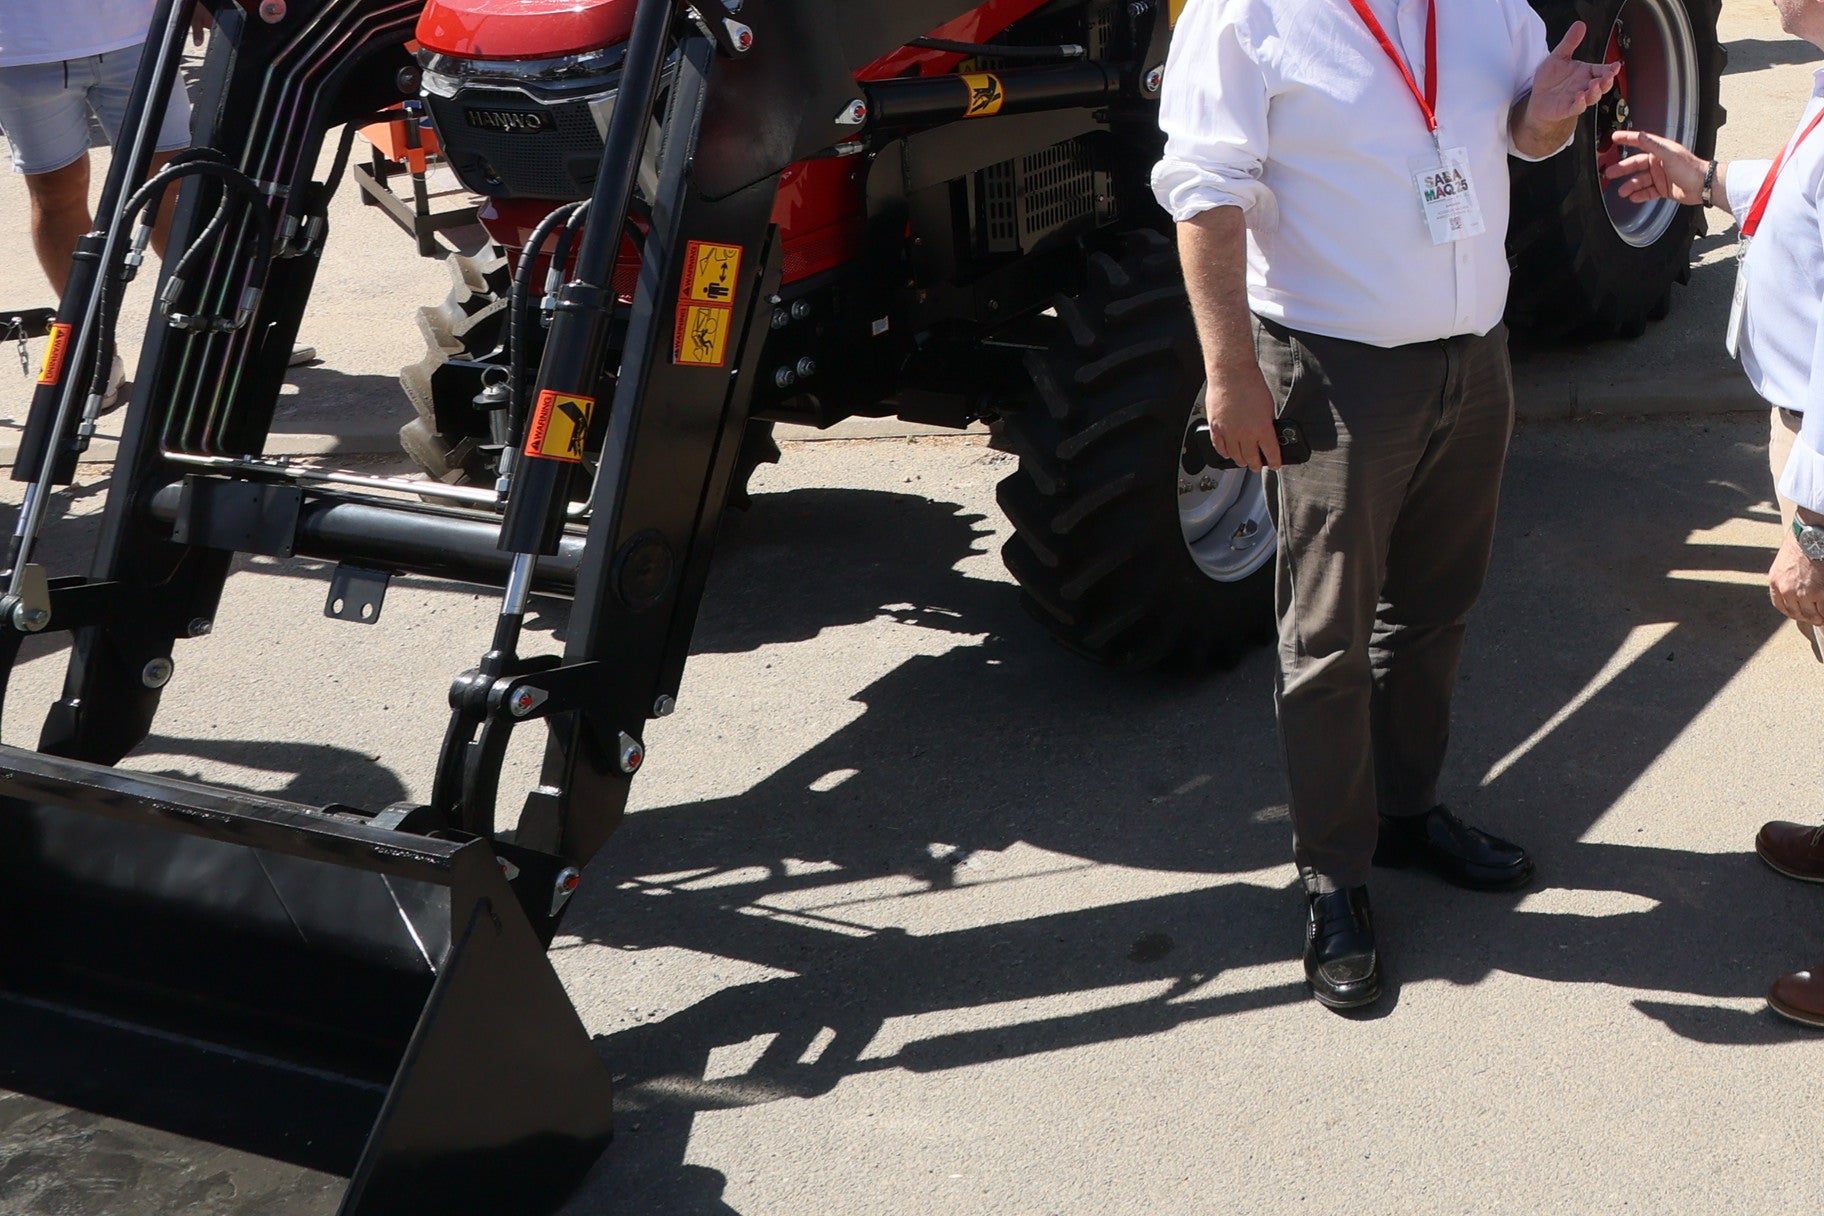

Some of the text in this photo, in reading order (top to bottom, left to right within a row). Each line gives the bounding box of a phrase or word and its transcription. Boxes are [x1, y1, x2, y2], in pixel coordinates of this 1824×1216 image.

[468, 109, 541, 129] HANWO
[1424, 183, 1456, 202] MAQ
[685, 245, 698, 285] WARNING
[534, 396, 553, 442] WARNING
